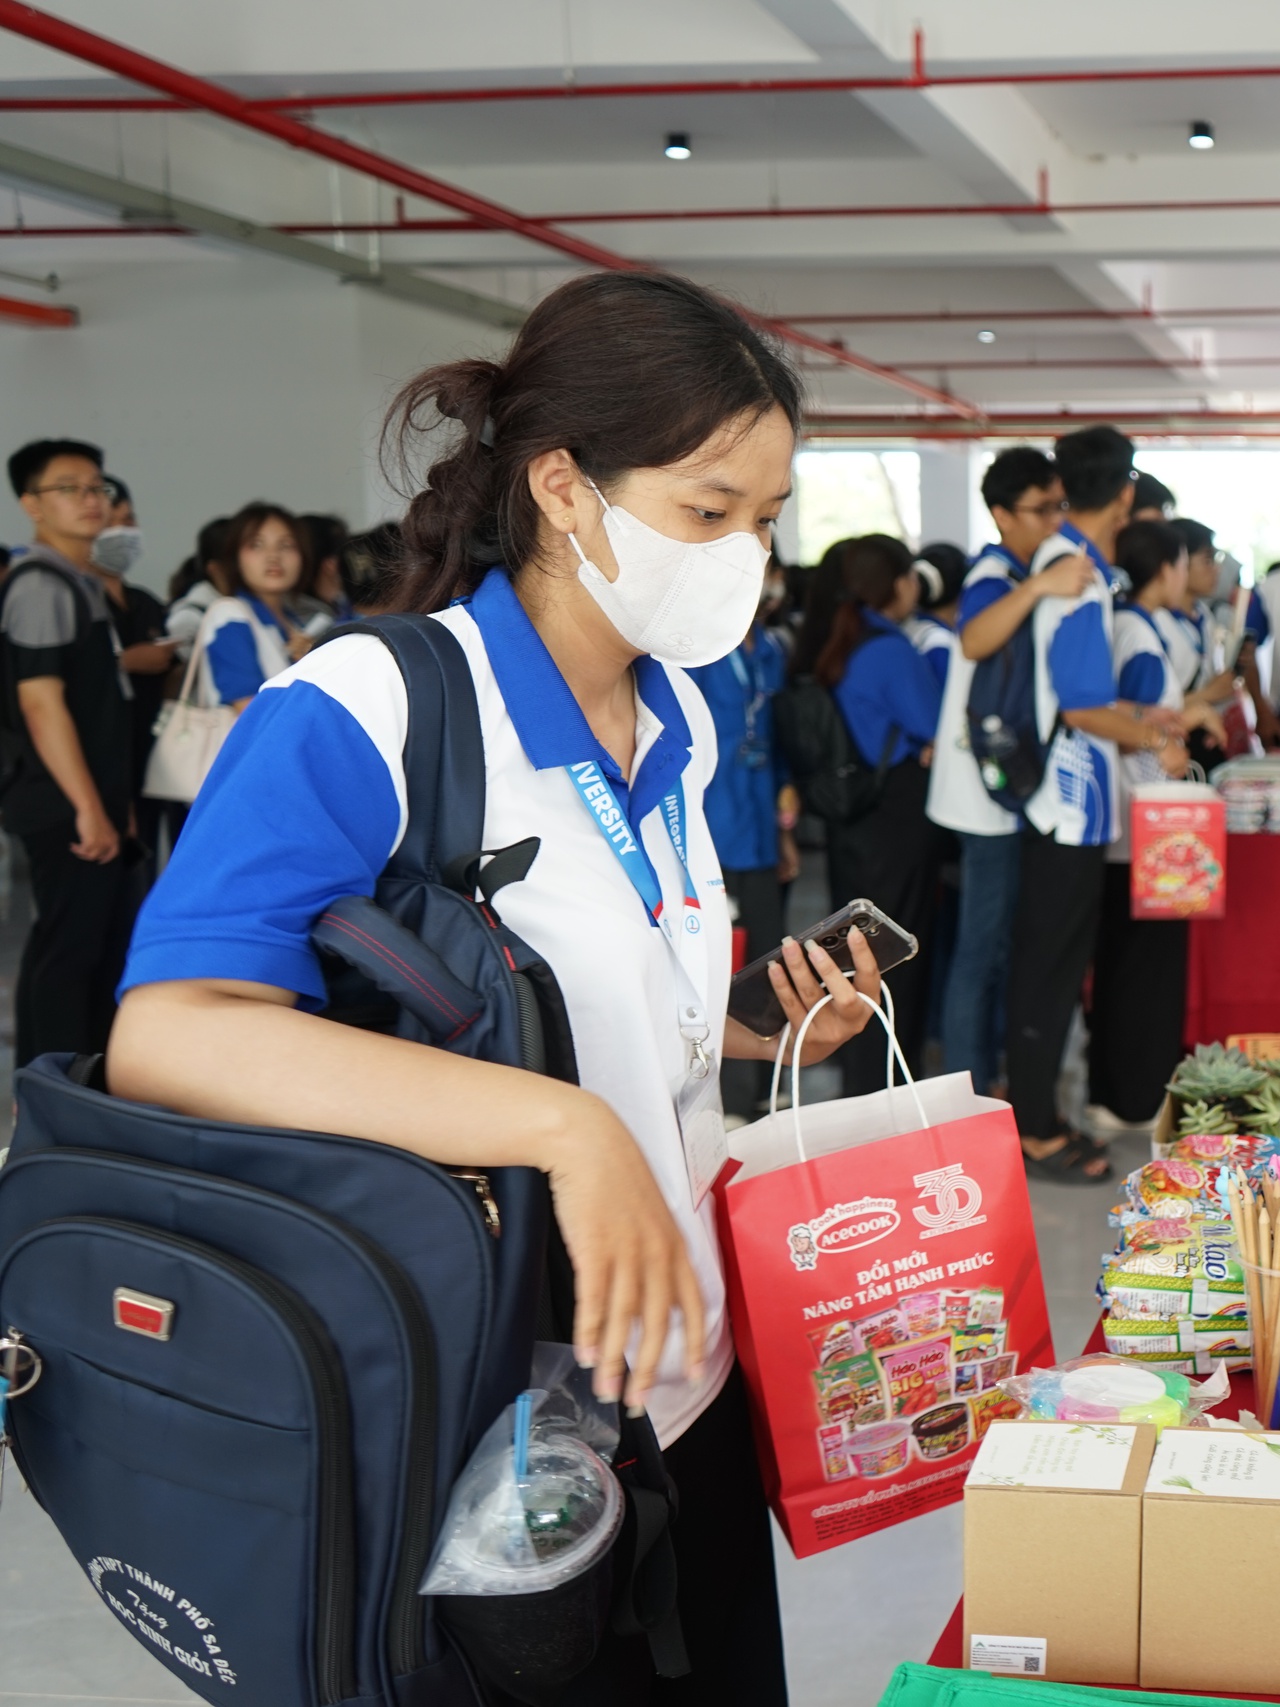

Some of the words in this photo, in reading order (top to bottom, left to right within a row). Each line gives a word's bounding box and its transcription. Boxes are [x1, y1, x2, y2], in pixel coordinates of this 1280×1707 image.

[664, 794, 688, 867] INTEGRAT
[811, 1207, 837, 1231] Cook
[838, 1198, 894, 1216] happiness
[803, 1296, 853, 1320] NÂNG
[855, 1283, 893, 1305] TẦM
[895, 1266, 944, 1292] HẠNH
[947, 1252, 994, 1276] PHÚC
[857, 1259, 890, 1285] ĐỔI
[893, 1250, 928, 1272] MỚI
[890, 1371, 925, 1397] BIG
[891, 1360, 917, 1378] Hảo
[919, 1349, 945, 1368] Hảo
[125, 1564, 175, 1602] THÀNH
[177, 1598, 215, 1630] PHỐ
[203, 1634, 221, 1655] SA
[137, 1618, 173, 1655] SINH
[174, 1646, 212, 1677] GIỎI
